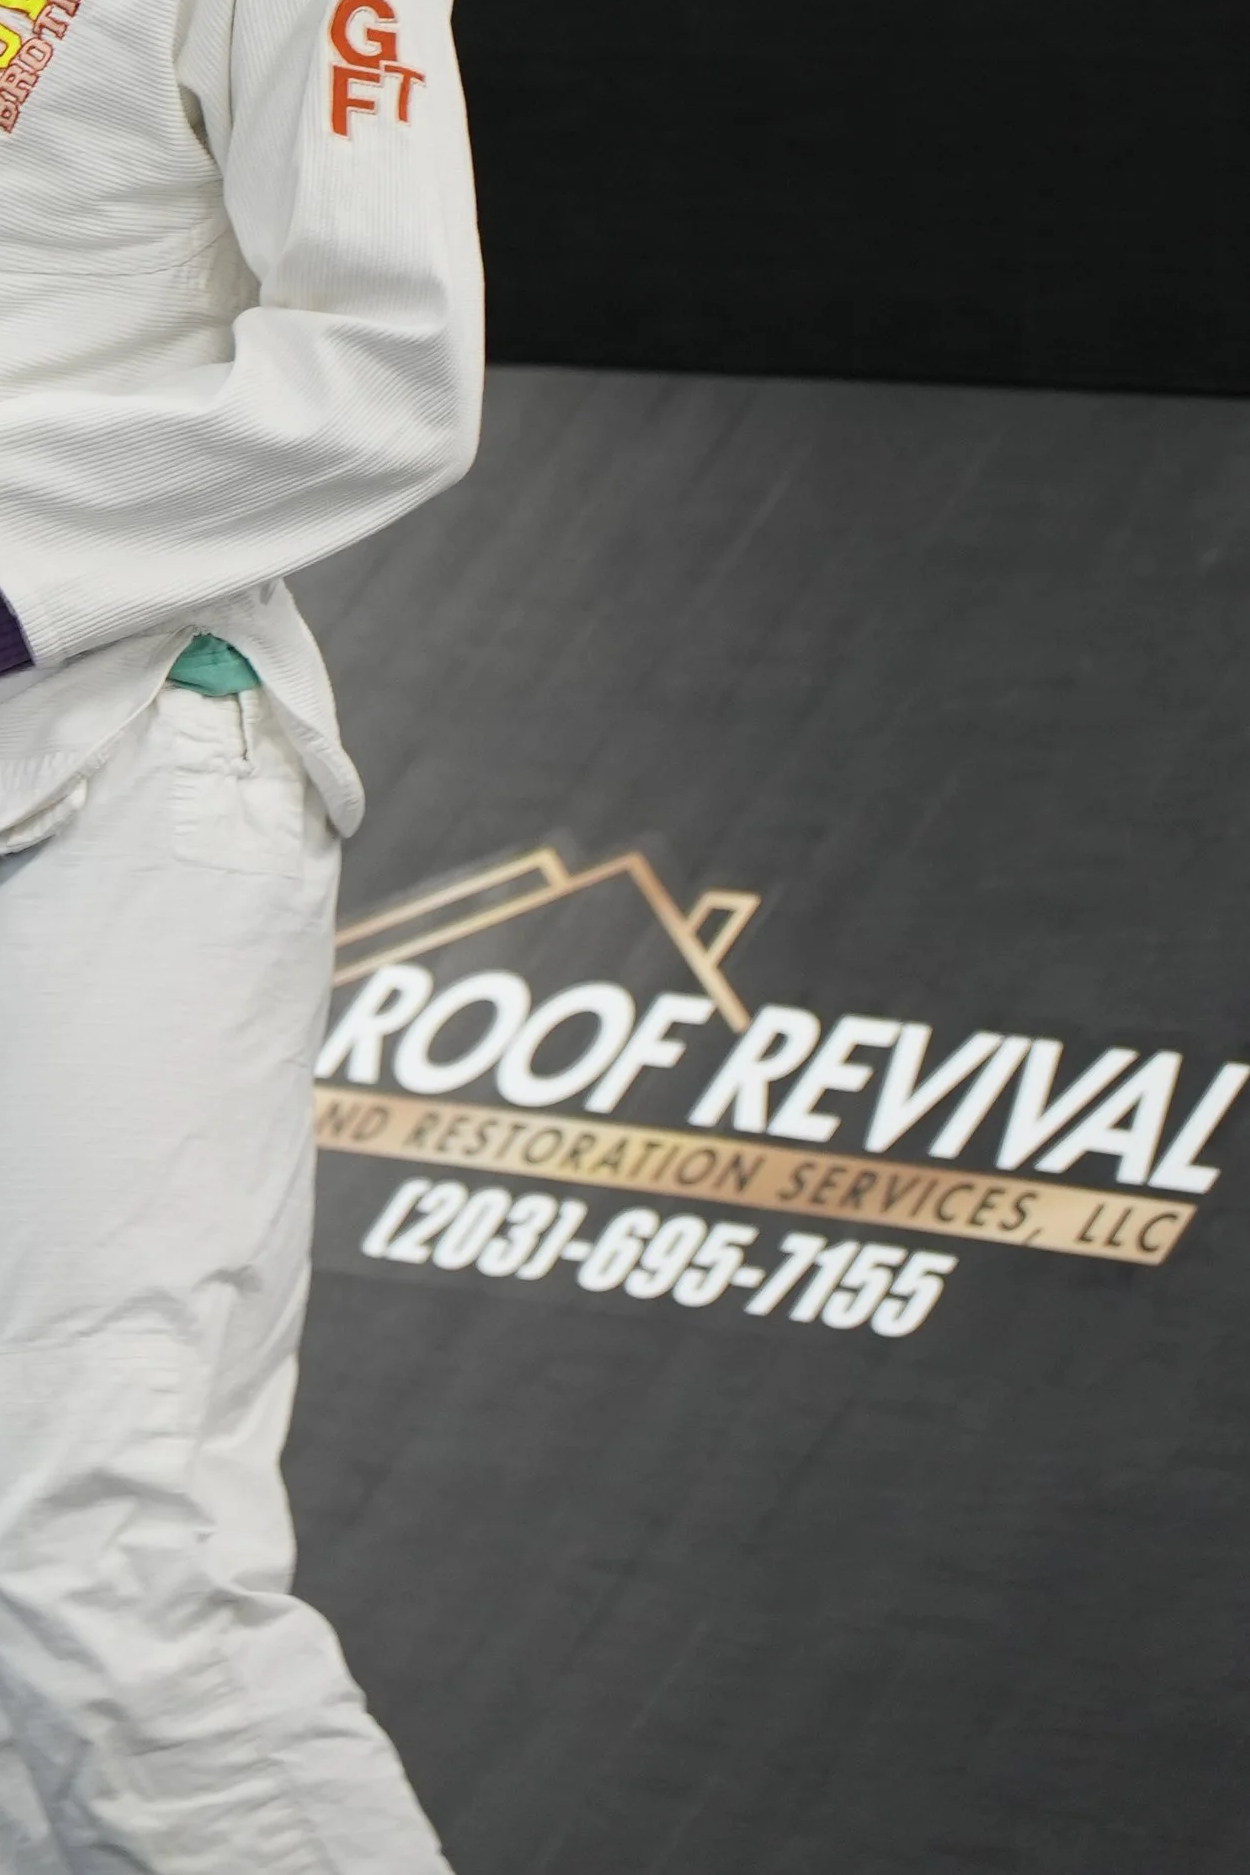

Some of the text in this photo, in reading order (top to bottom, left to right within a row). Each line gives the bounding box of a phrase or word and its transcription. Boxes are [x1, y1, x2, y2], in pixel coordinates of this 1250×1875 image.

[314, 962, 1250, 1195] ROOF REVIVAL
[360, 1175, 959, 1339] (203)-695-7155
[403, 1109, 768, 1195] RESTORATION
[778, 1162, 1040, 1248] SERVICES,
[1074, 1203, 1179, 1255] LLC
